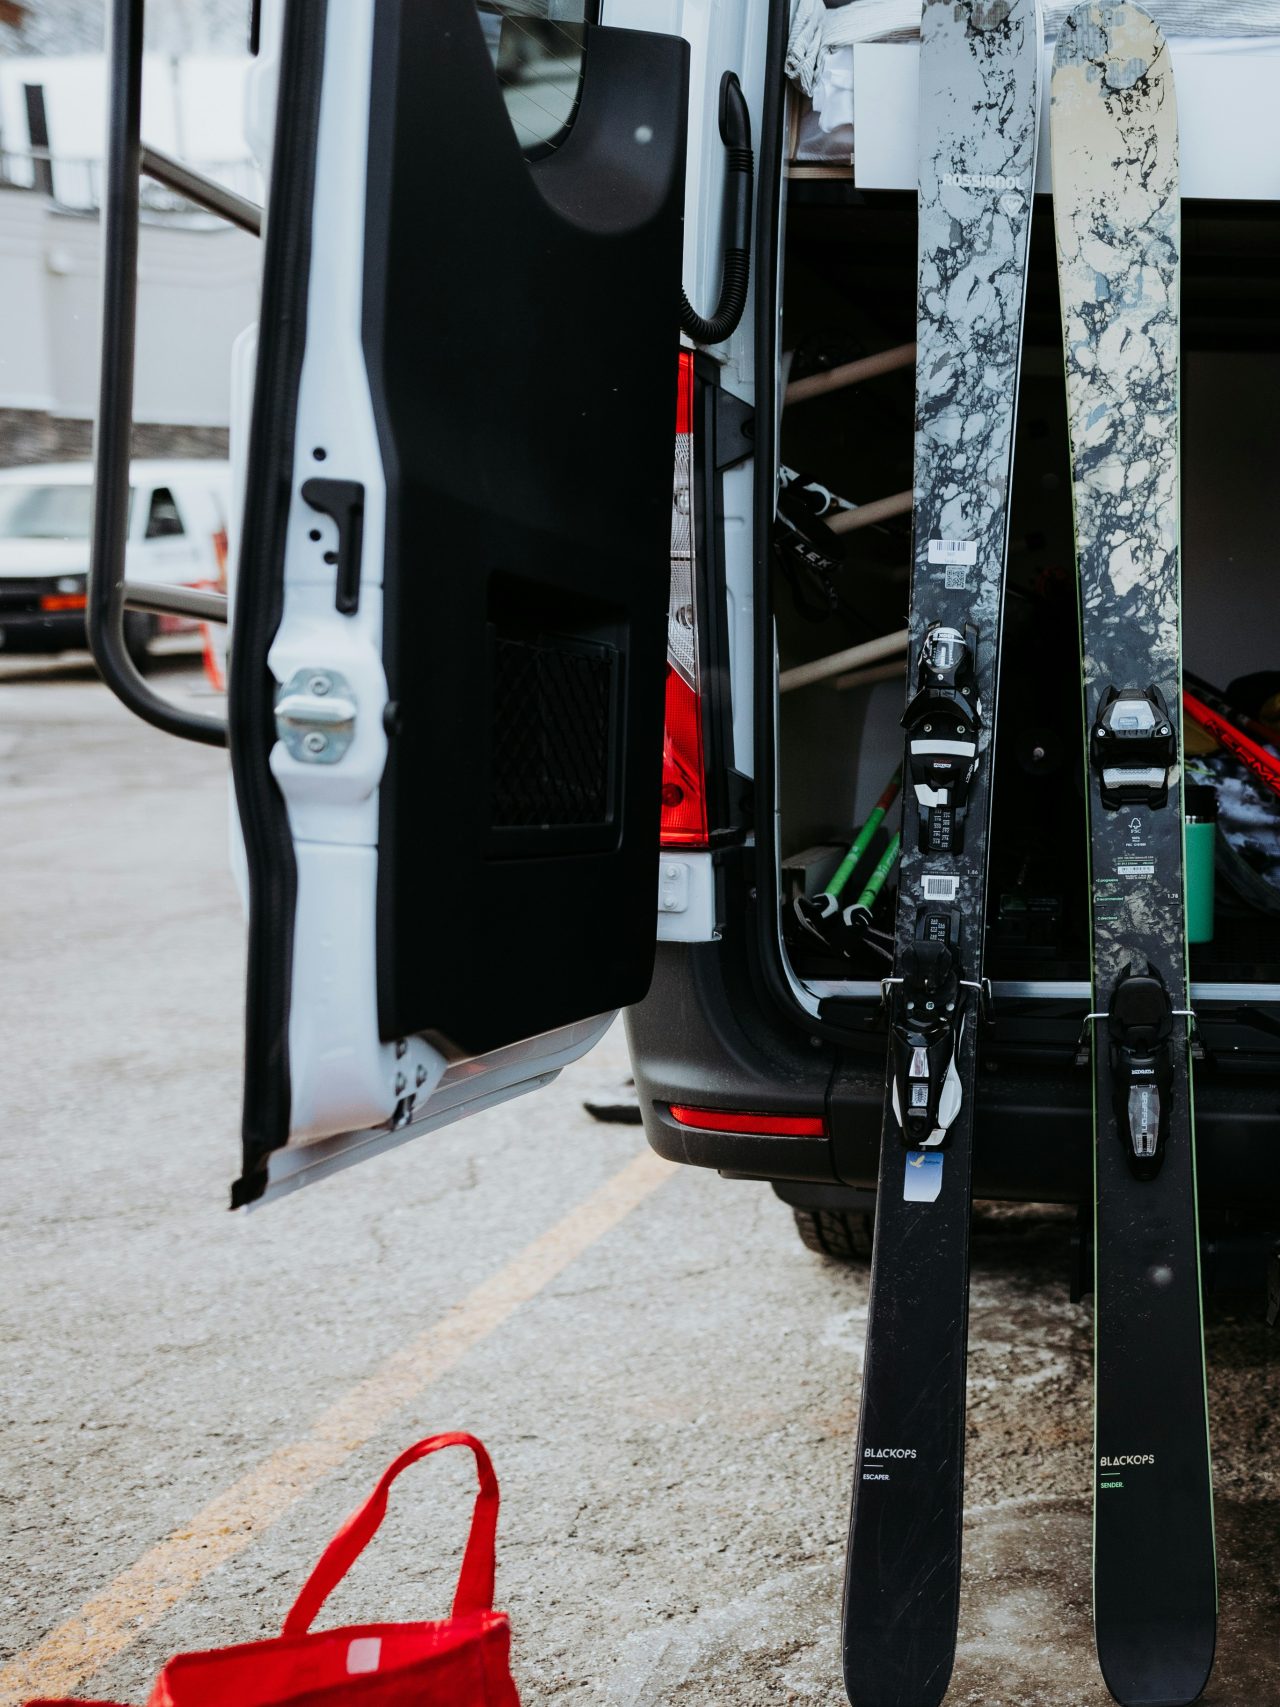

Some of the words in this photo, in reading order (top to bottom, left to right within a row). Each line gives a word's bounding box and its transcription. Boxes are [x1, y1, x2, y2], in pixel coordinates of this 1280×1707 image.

[942, 173, 1026, 190] ROSSIGNOL
[864, 1448, 917, 1458] BLACKOPS
[1100, 1454, 1155, 1467] BLACKOPS
